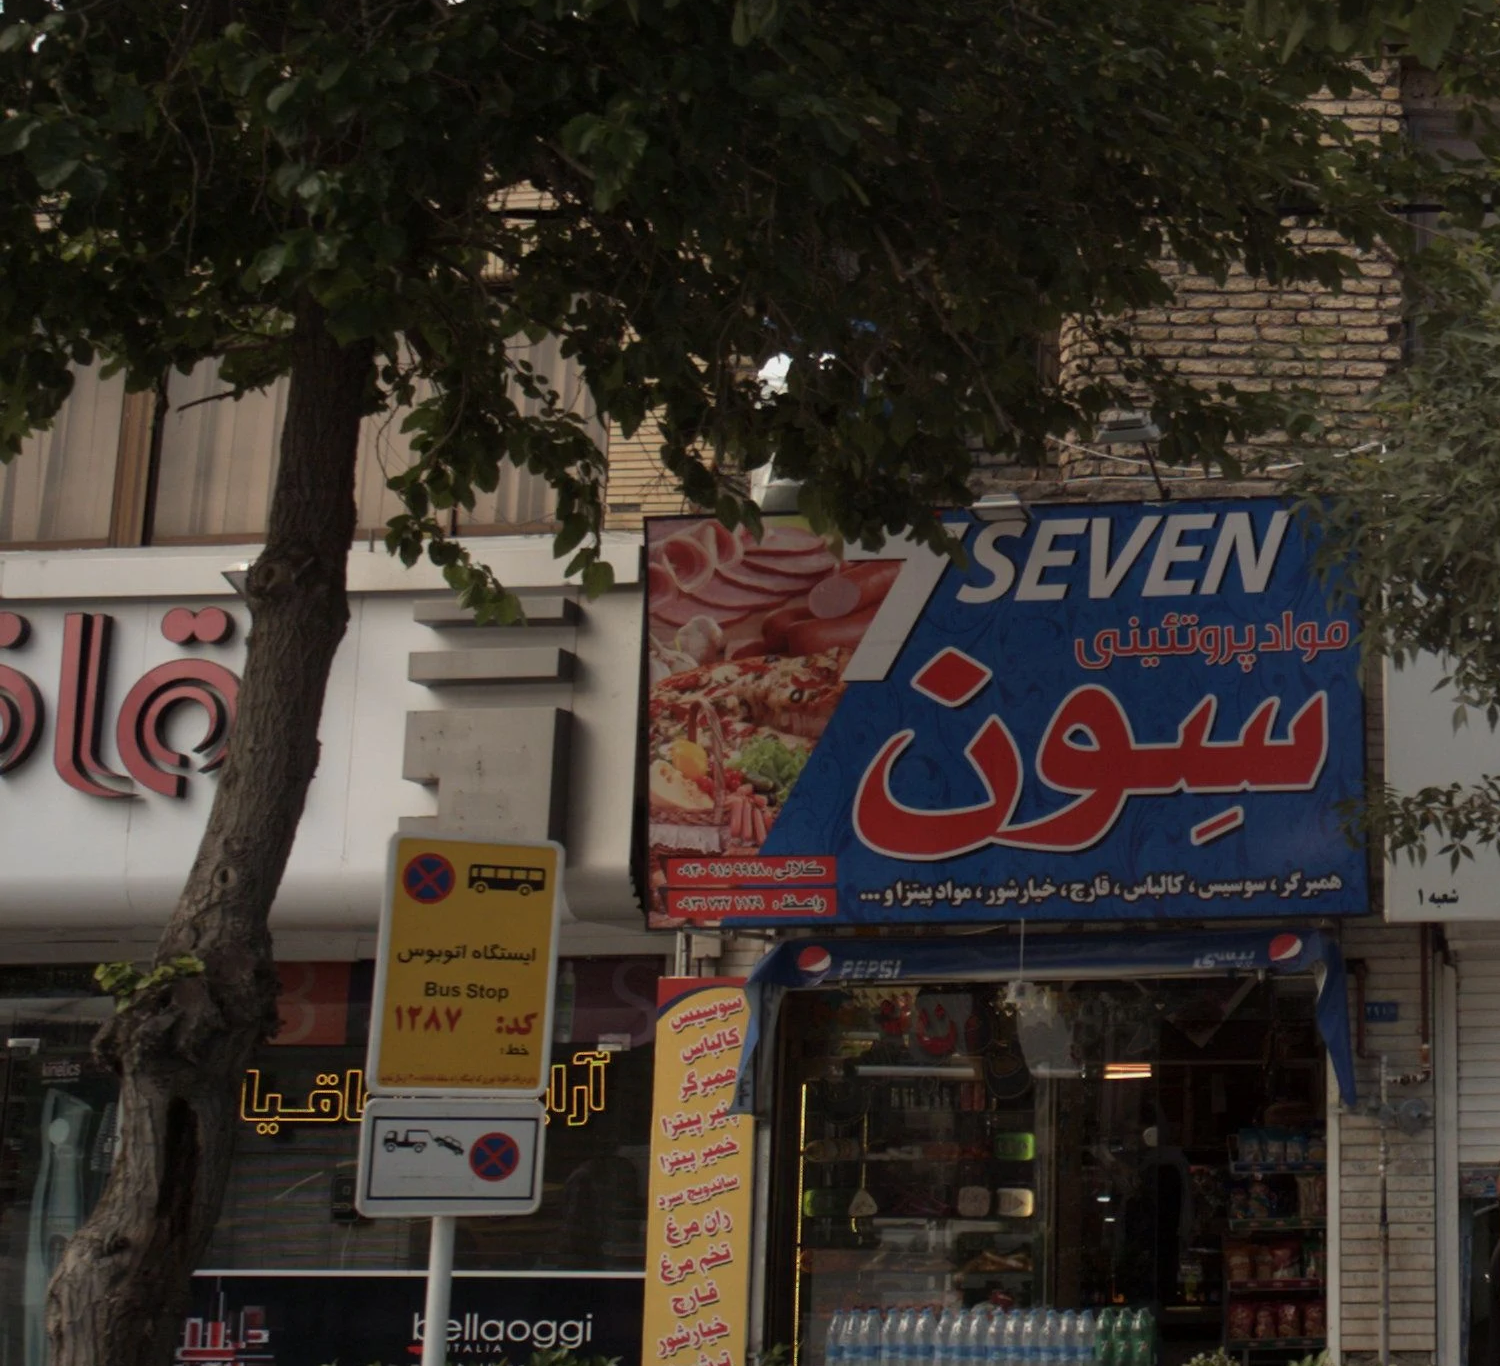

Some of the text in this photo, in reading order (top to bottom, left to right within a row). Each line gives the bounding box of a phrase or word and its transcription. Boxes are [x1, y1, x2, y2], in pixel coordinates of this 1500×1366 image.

[955, 509, 1294, 605] SEVEN
[1074, 611, 1349, 673] مواد پروتئینی
[1428, 888, 1459, 908] شعبه
[397, 944, 537, 965] ایستگاه اتوبوس
[840, 958, 902, 979] PEPSI
[424, 981, 509, 1002] Bus Stop
[670, 995, 743, 1032] سوسیس
[681, 1027, 741, 1065] کالباس
[662, 1113, 703, 1140] پیتزا
[660, 1137, 739, 1176] خمیر پیتزا
[658, 1192, 684, 1211] سرد
[666, 1209, 733, 1248] ران مرغ
[660, 1243, 733, 1285] تخم مرغ
[671, 1282, 720, 1318] قارچ
[412, 1312, 594, 1350] bellaoggi
[446, 1343, 503, 1354] ITALIA
[659, 1316, 730, 1358] خیارشور
